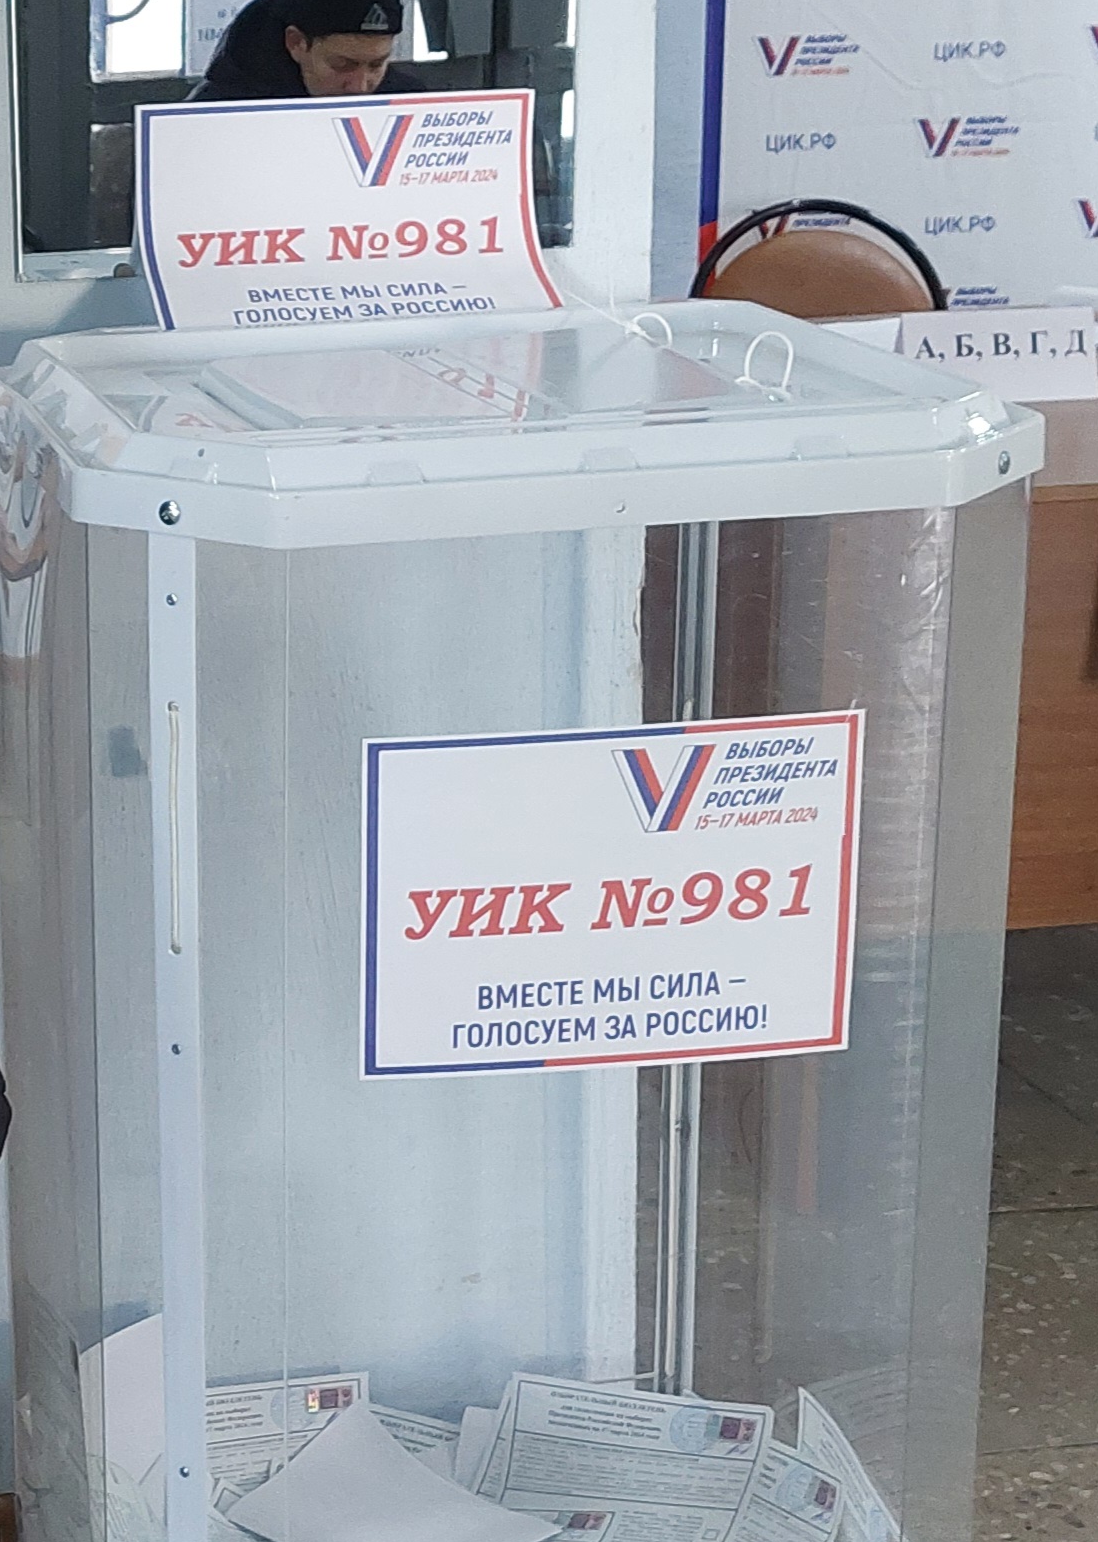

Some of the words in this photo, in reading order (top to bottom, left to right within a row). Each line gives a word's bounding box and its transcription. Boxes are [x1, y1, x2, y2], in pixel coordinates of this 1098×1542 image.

[933, 40, 1007, 62] ЦИК.РФ
[421, 111, 494, 128] ВЫБОРЫ
[412, 129, 513, 148] ПРЕЗИДЕНТА
[765, 132, 837, 154] ЦИК.РФ
[404, 151, 469, 168] РОССИИ
[430, 170, 470, 185] МАРТА
[470, 168, 499, 182] 2024
[924, 214, 996, 236] ЦИК.РФ
[177, 227, 306, 268] УИК
[326, 216, 504, 260] №981
[247, 286, 336, 303] ВМЕСТЕ
[339, 284, 382, 300] МЫ
[386, 281, 448, 298] СИЛА
[232, 306, 353, 326] ГОЛОСУЕМ
[358, 302, 388, 317] ЗА
[393, 296, 497, 316] РОССИЮ!
[915, 335, 946, 363] А,
[955, 332, 984, 362] Б,
[992, 331, 1021, 360] В,
[1030, 329, 1057, 358] Г,
[1064, 328, 1089, 357] Д
[725, 736, 815, 760] ВЫБОРЫ
[713, 758, 839, 785] ПРЕЗИДЕНТА
[702, 786, 785, 809] РОССИИ
[734, 809, 783, 827] МАРТА
[784, 806, 819, 824] 2024
[403, 881, 572, 941] УИК
[589, 862, 813, 931] №981
[477, 979, 584, 1010] ВМЕСТЕ
[593, 975, 641, 1004] МЫ
[649, 970, 721, 1000] СИЛА
[452, 1016, 597, 1049] ГОЛОСУЕМ
[604, 1013, 637, 1040] ЗА
[646, 1003, 768, 1038] РОССИЮ!
